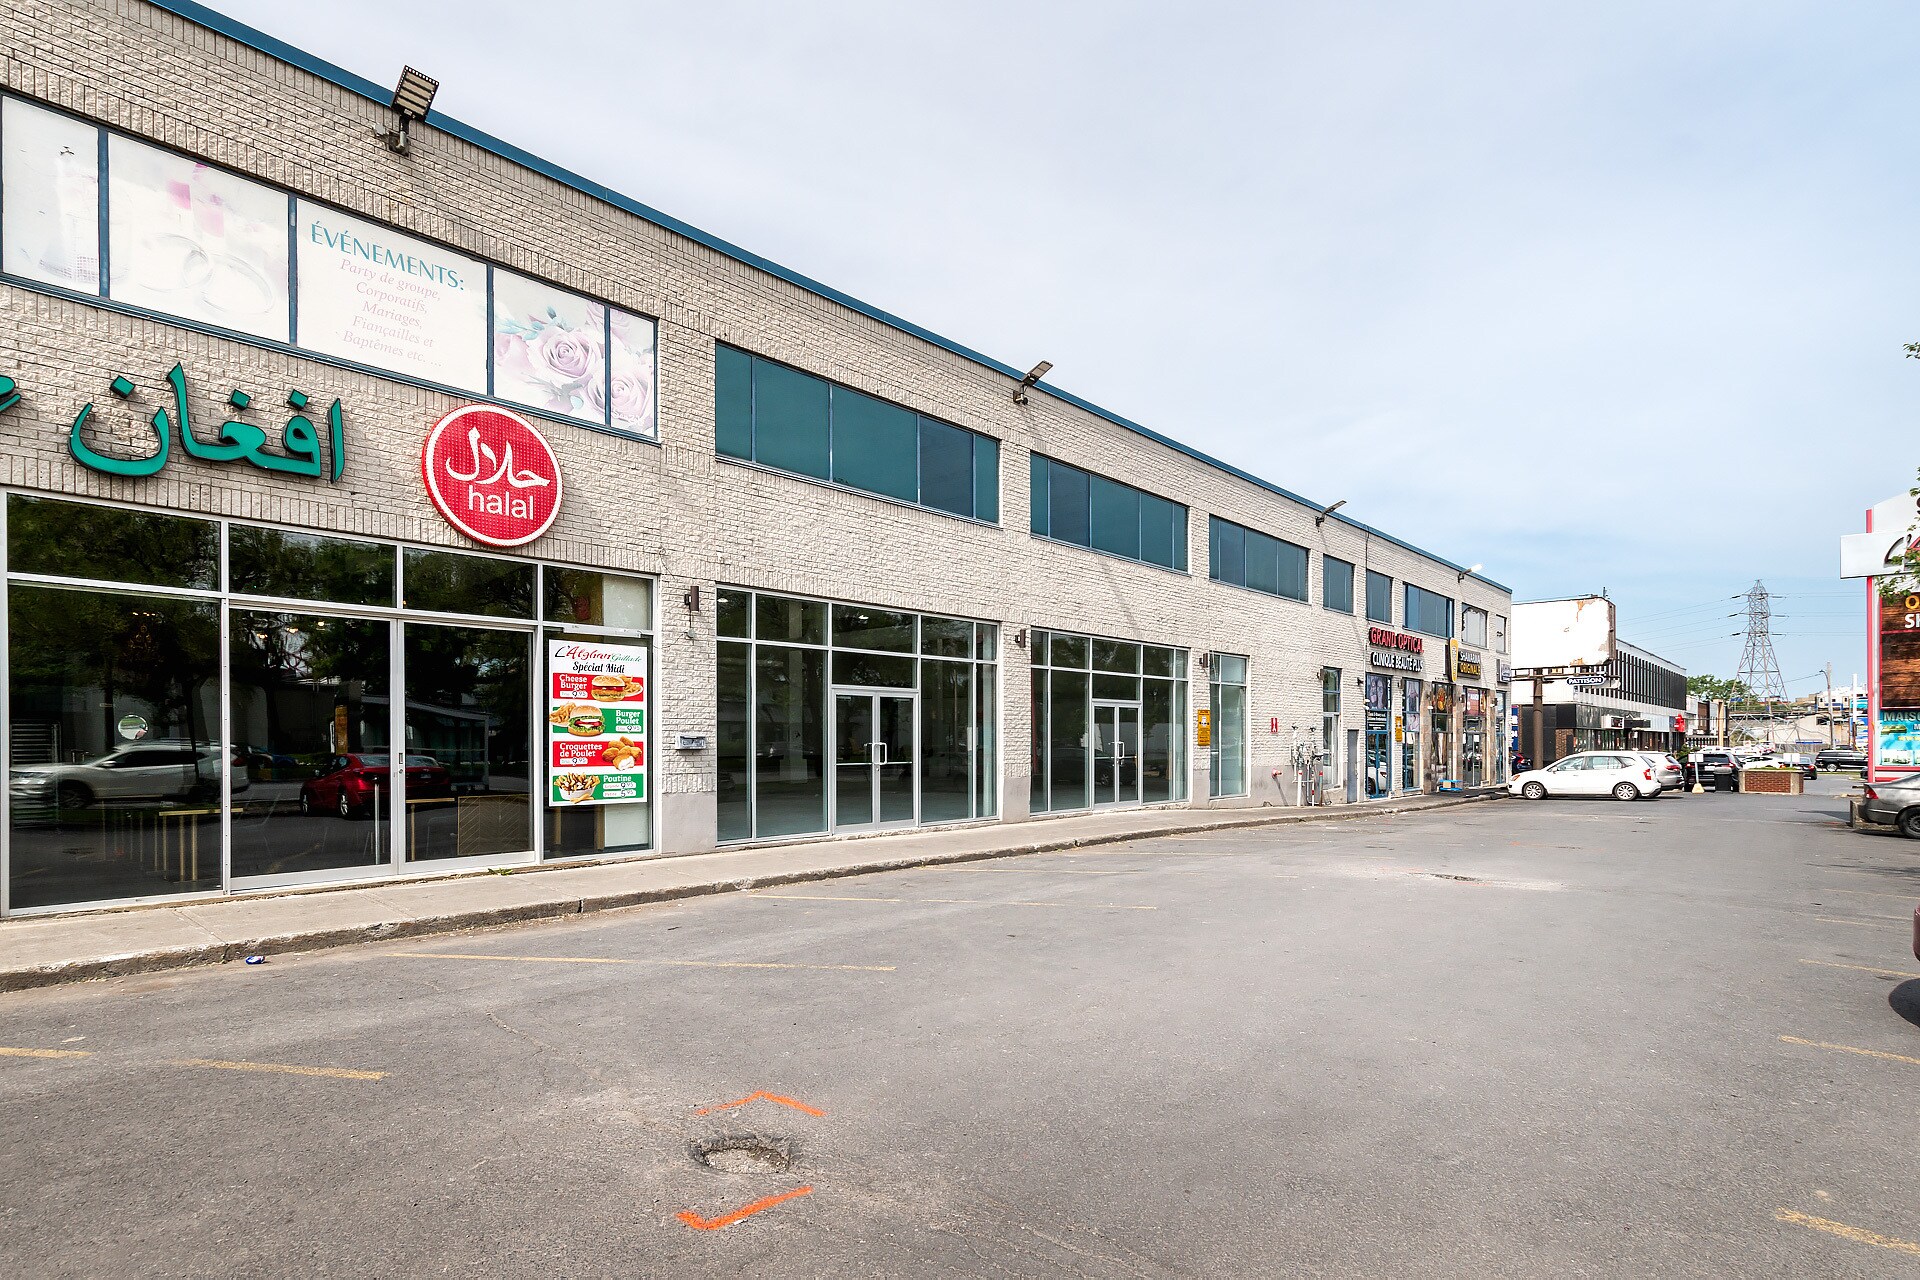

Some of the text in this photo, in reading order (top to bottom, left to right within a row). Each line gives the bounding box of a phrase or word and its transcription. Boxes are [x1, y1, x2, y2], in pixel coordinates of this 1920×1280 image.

[311, 220, 465, 291] ÉVÉNEMENTS:
[340, 258, 441, 301] Party de groupe,
[356, 281, 428, 315] Corporatifs,
[362, 300, 423, 330] Mariages,
[343, 330, 404, 357] Baptêmes
[352, 315, 434, 348] Fiançailles et
[445, 426, 551, 489] حلال
[468, 485, 534, 521] halal
[1371, 627, 1425, 653] GRAND OPTICAL
[572, 661, 625, 674] Spécial Midi
[1372, 652, 1424, 673] CLINIQUE BEAUTÉ PLUS
[559, 674, 588, 683] Cheese
[560, 682, 588, 691] Burger
[615, 710, 641, 720] Burger
[615, 717, 639, 725] Poulet
[559, 743, 603, 752] Croquettes
[603, 774, 632, 782] Poutine
